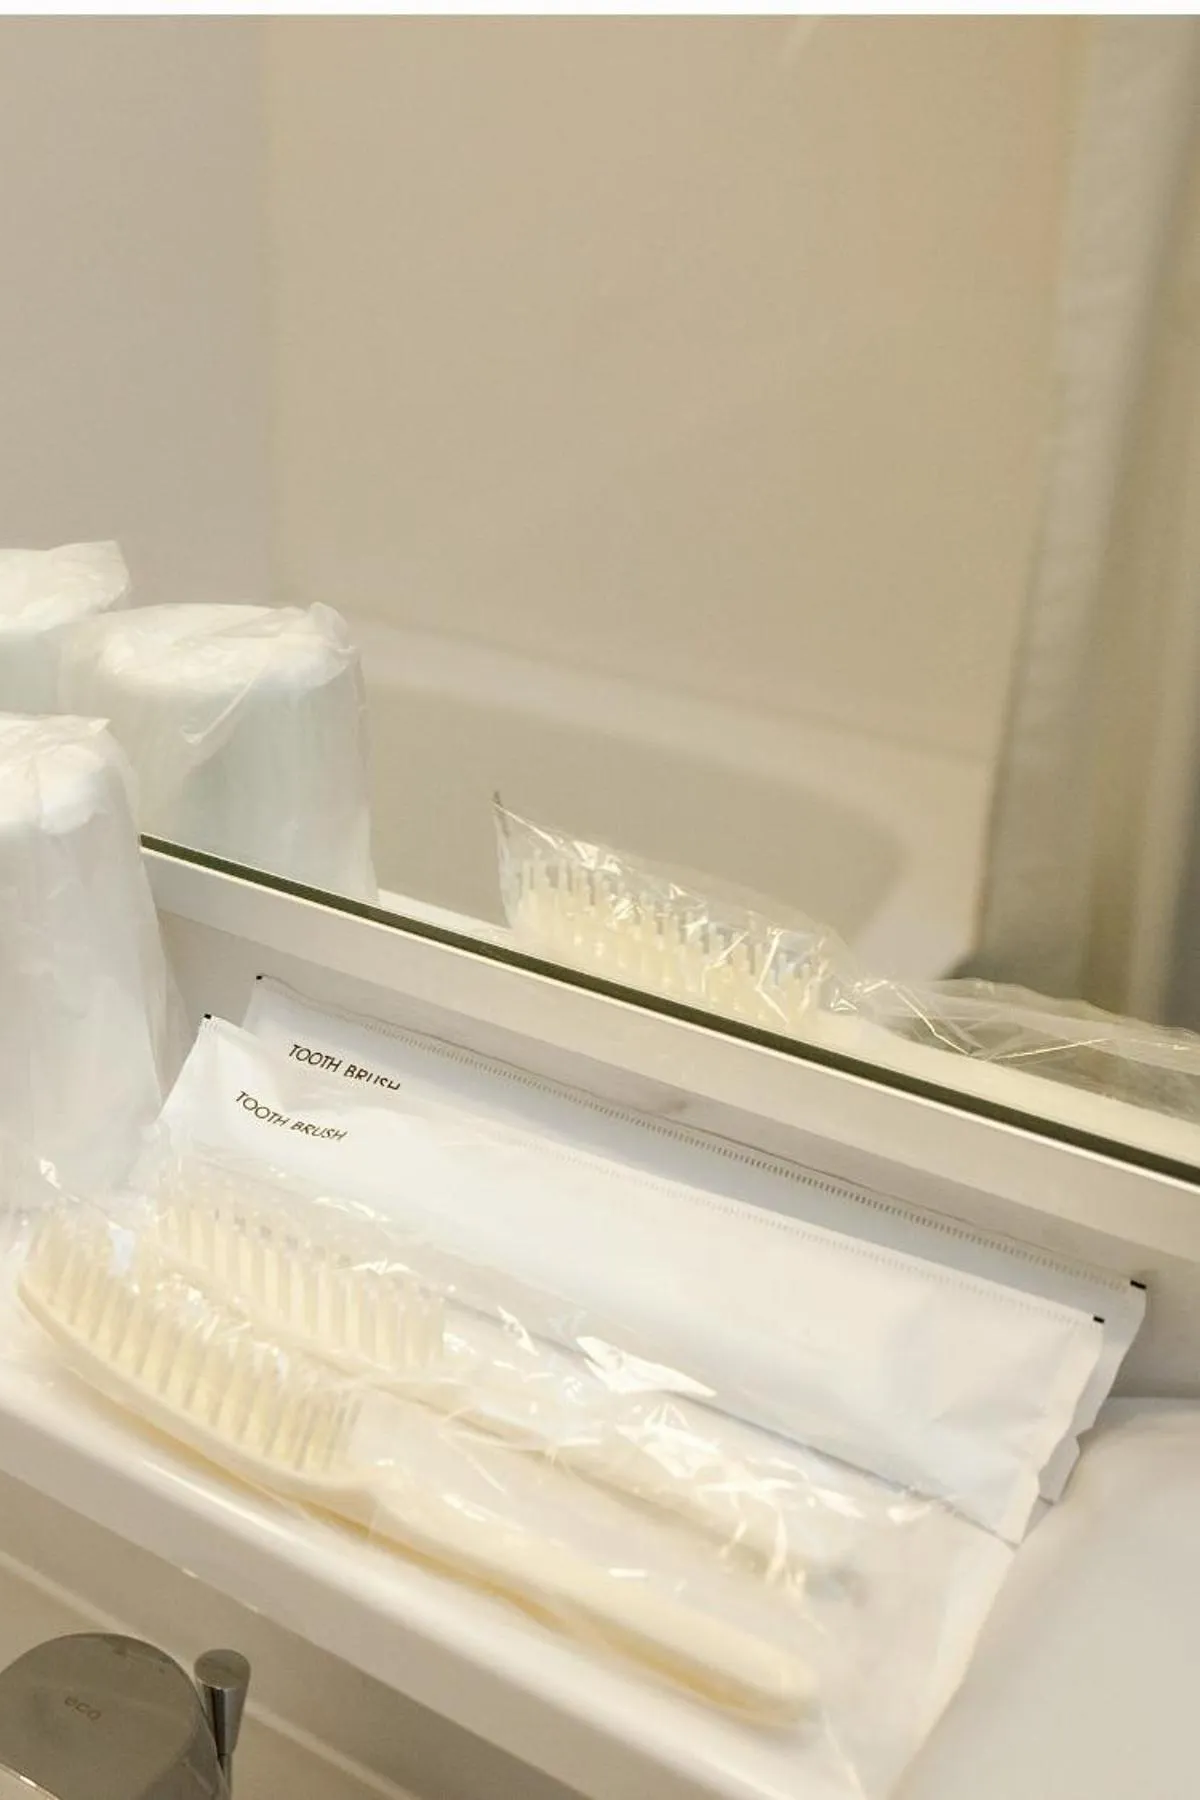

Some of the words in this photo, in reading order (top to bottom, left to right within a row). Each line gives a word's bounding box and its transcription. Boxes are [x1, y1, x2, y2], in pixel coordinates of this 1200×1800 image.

[288, 1043, 343, 1073] TOOTH
[235, 1090, 290, 1127] TOOTH
[289, 1120, 348, 1142] BRUSH
[64, 1695, 102, 1722] eco
